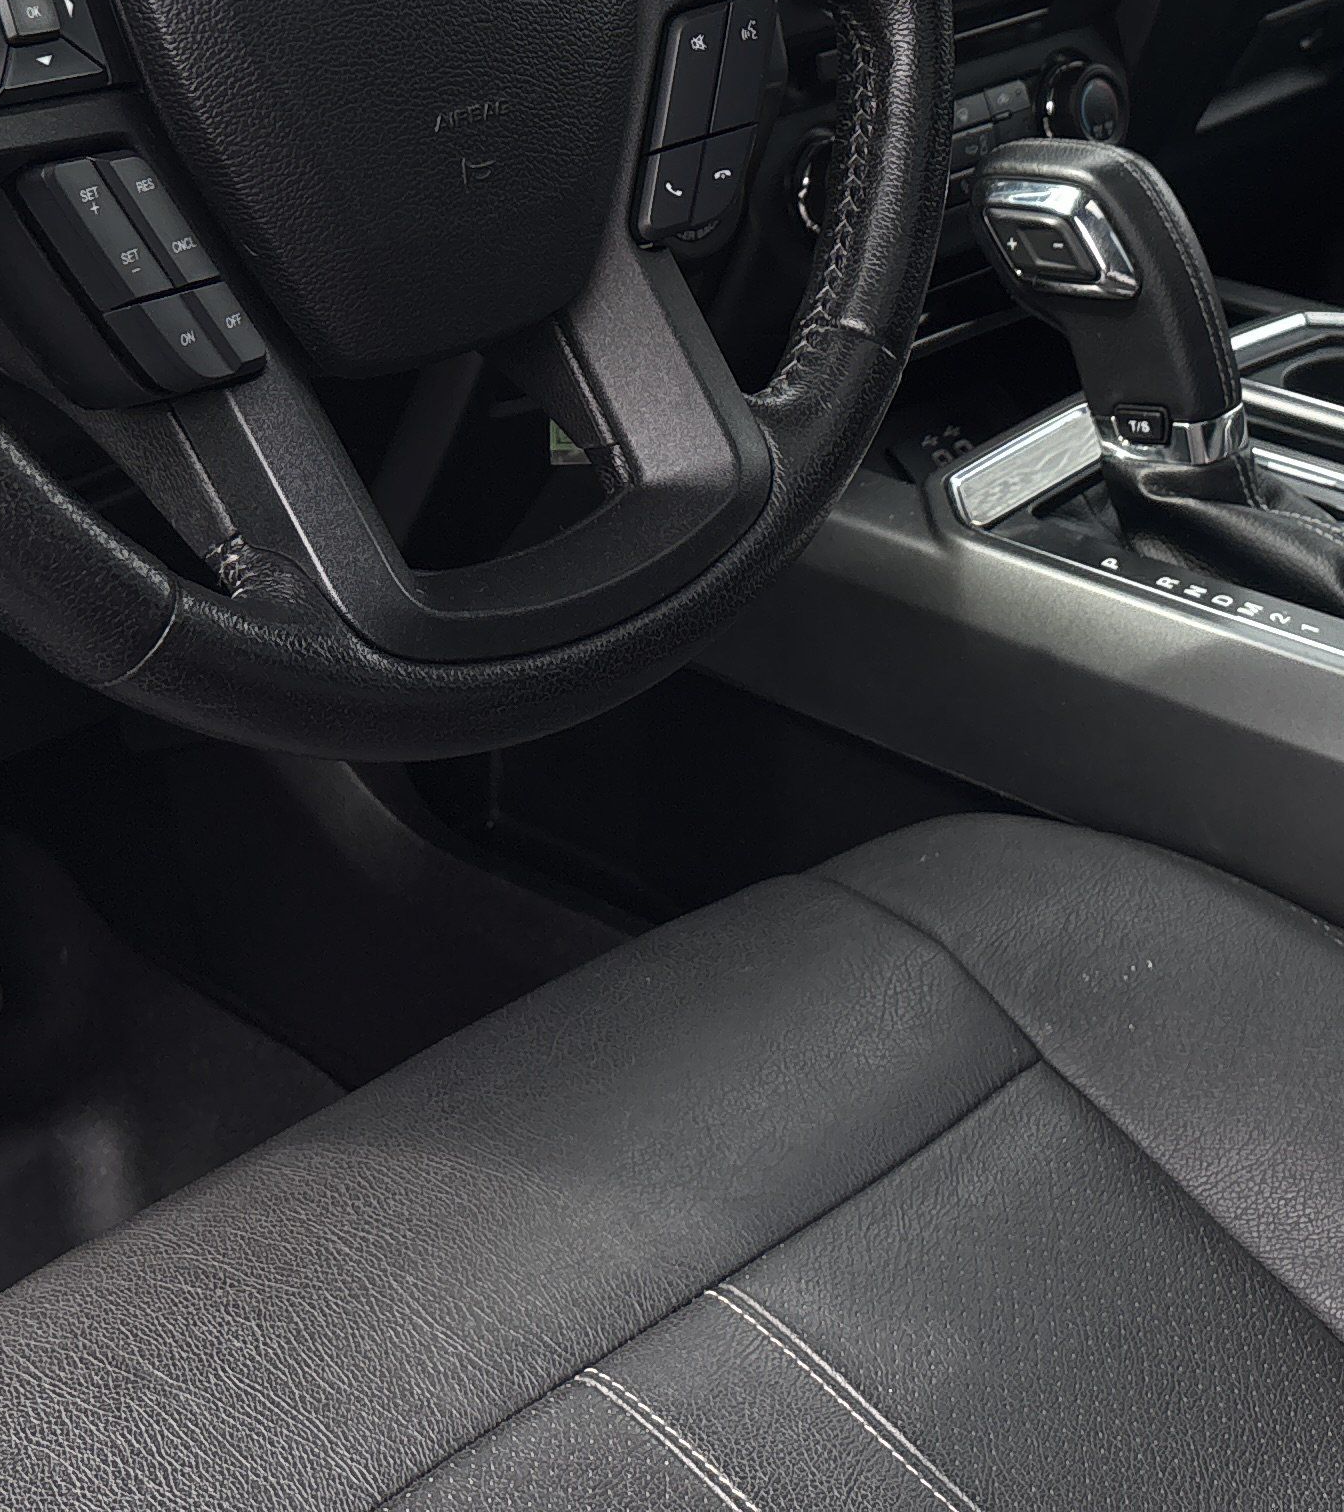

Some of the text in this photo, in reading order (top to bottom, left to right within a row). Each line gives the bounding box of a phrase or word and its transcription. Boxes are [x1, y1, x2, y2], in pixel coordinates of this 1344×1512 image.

[26, 3, 43, 20] OK
[136, 177, 156, 194] RES
[79, 186, 100, 203] SET
[171, 236, 197, 255] CNCL
[120, 248, 139, 266] SET
[224, 313, 244, 330] OFF
[180, 330, 196, 347] ON
[1100, 557, 1320, 634] P R N D M 2 1
